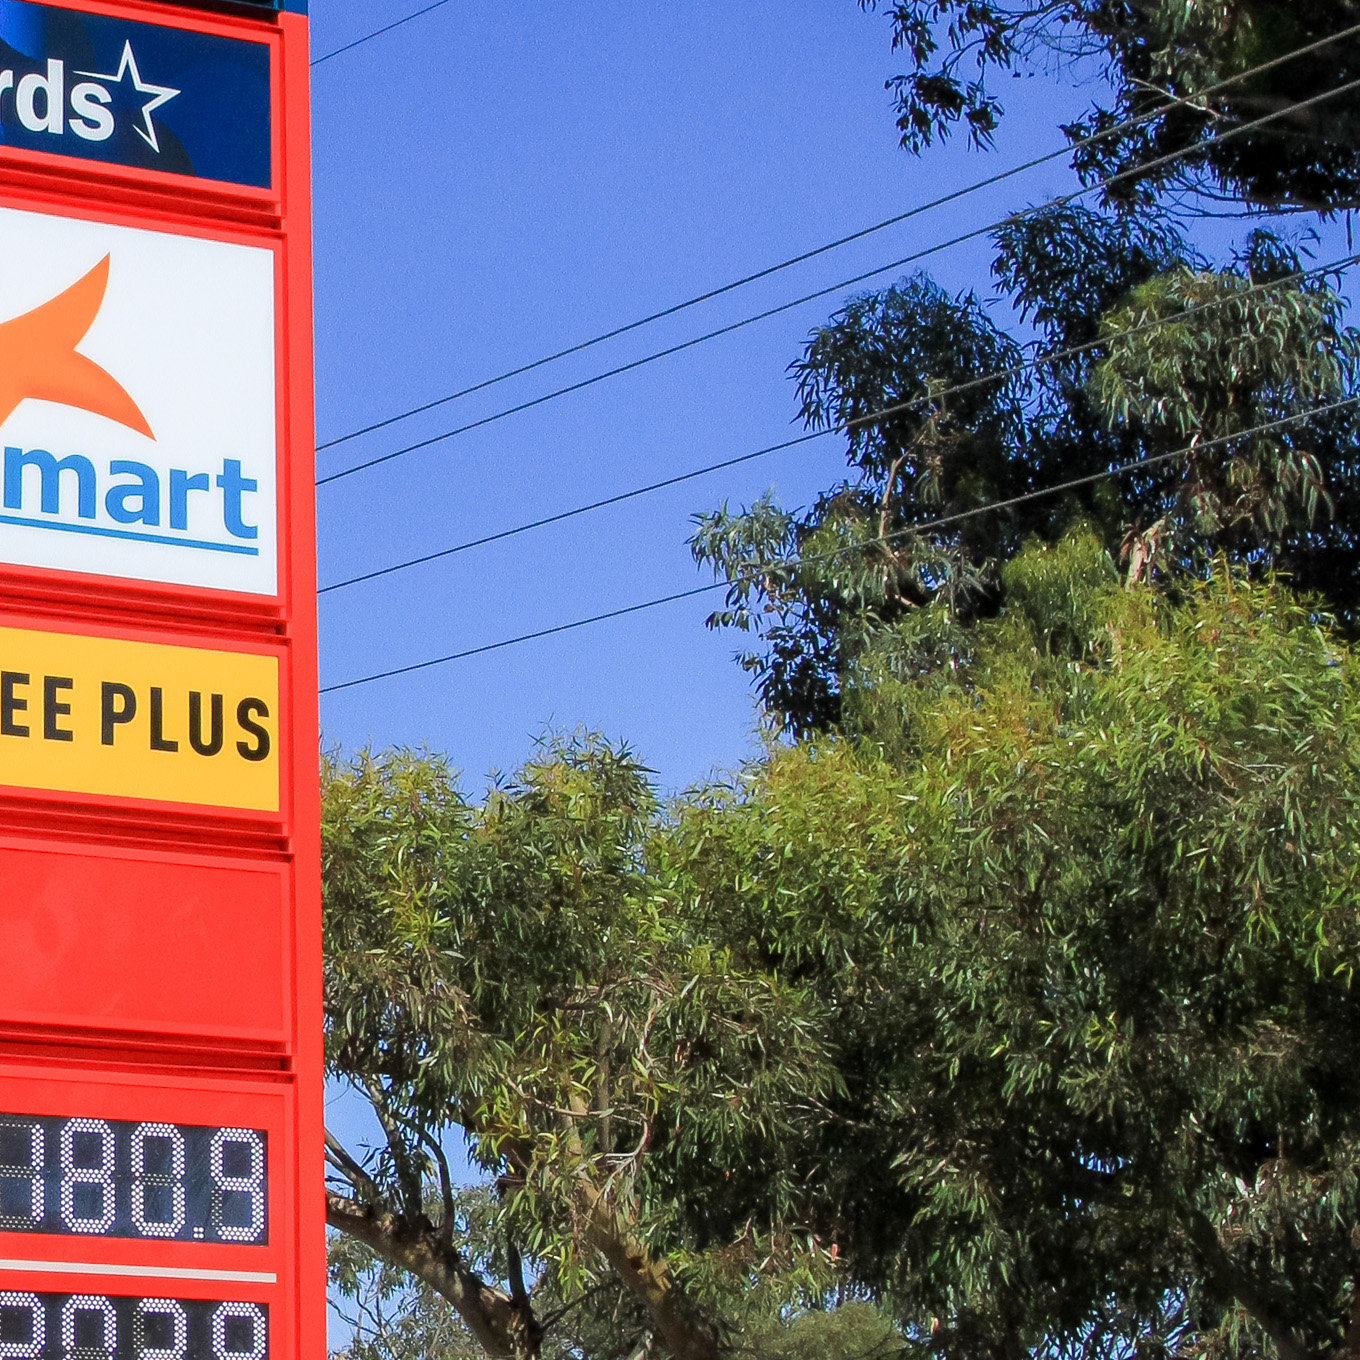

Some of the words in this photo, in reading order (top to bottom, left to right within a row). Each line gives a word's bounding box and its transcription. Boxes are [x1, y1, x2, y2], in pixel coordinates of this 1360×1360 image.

[2, 445, 259, 539] mart
[100, 681, 271, 762] PLUS
[31, 1117, 266, 1242] 180.9
